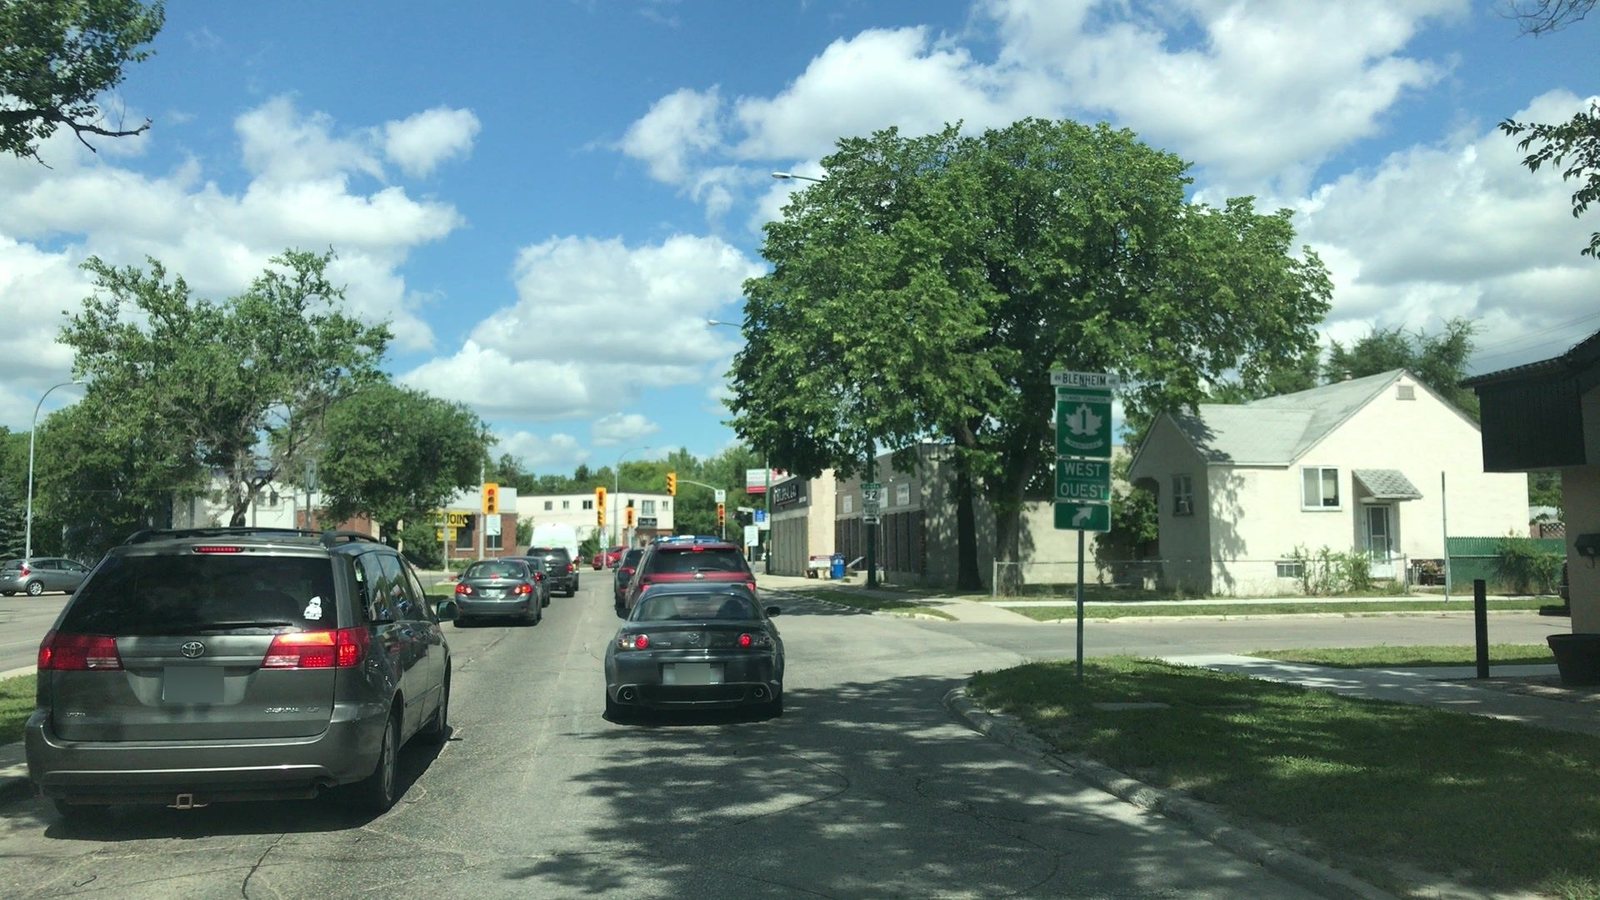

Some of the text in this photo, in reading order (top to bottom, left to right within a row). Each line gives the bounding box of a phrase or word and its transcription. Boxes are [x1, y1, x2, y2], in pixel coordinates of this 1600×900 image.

[1062, 373, 1106, 386] BLENHEIM
[1081, 409, 1087, 430] 1
[1063, 462, 1102, 477] WEST
[864, 490, 878, 500] 52
[1060, 482, 1106, 499] OUEST
